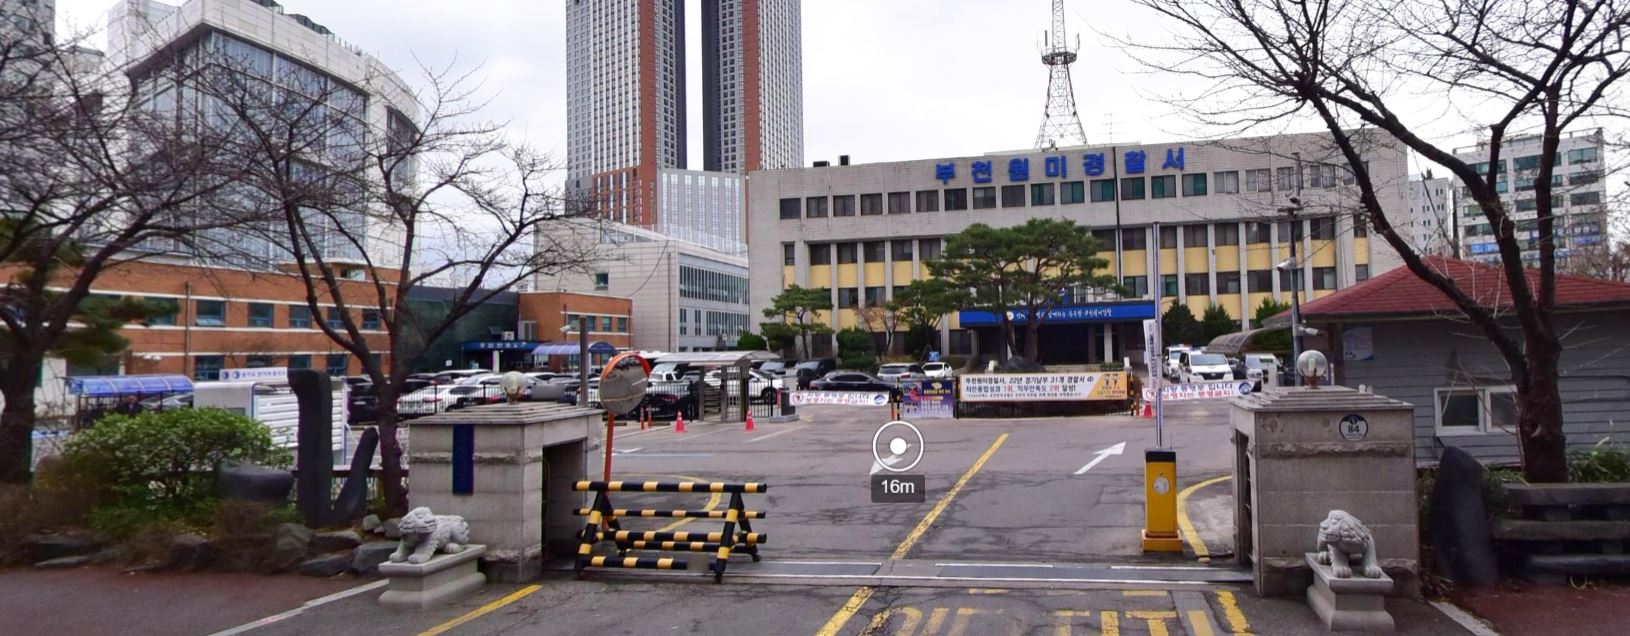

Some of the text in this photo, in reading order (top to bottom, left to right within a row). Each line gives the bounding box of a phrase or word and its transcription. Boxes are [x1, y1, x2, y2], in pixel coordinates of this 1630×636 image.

[936, 146, 1185, 185] 부천원미경찰서
[1025, 376, 1048, 384] 경기남부
[1050, 376, 1065, 384] 31개
[1067, 375, 1085, 384] 경찰서
[1017, 384, 1047, 393] 직무만족도
[1049, 384, 1060, 392] 2위
[1062, 384, 1076, 392] 달성!
[1347, 424, 1360, 434] 84
